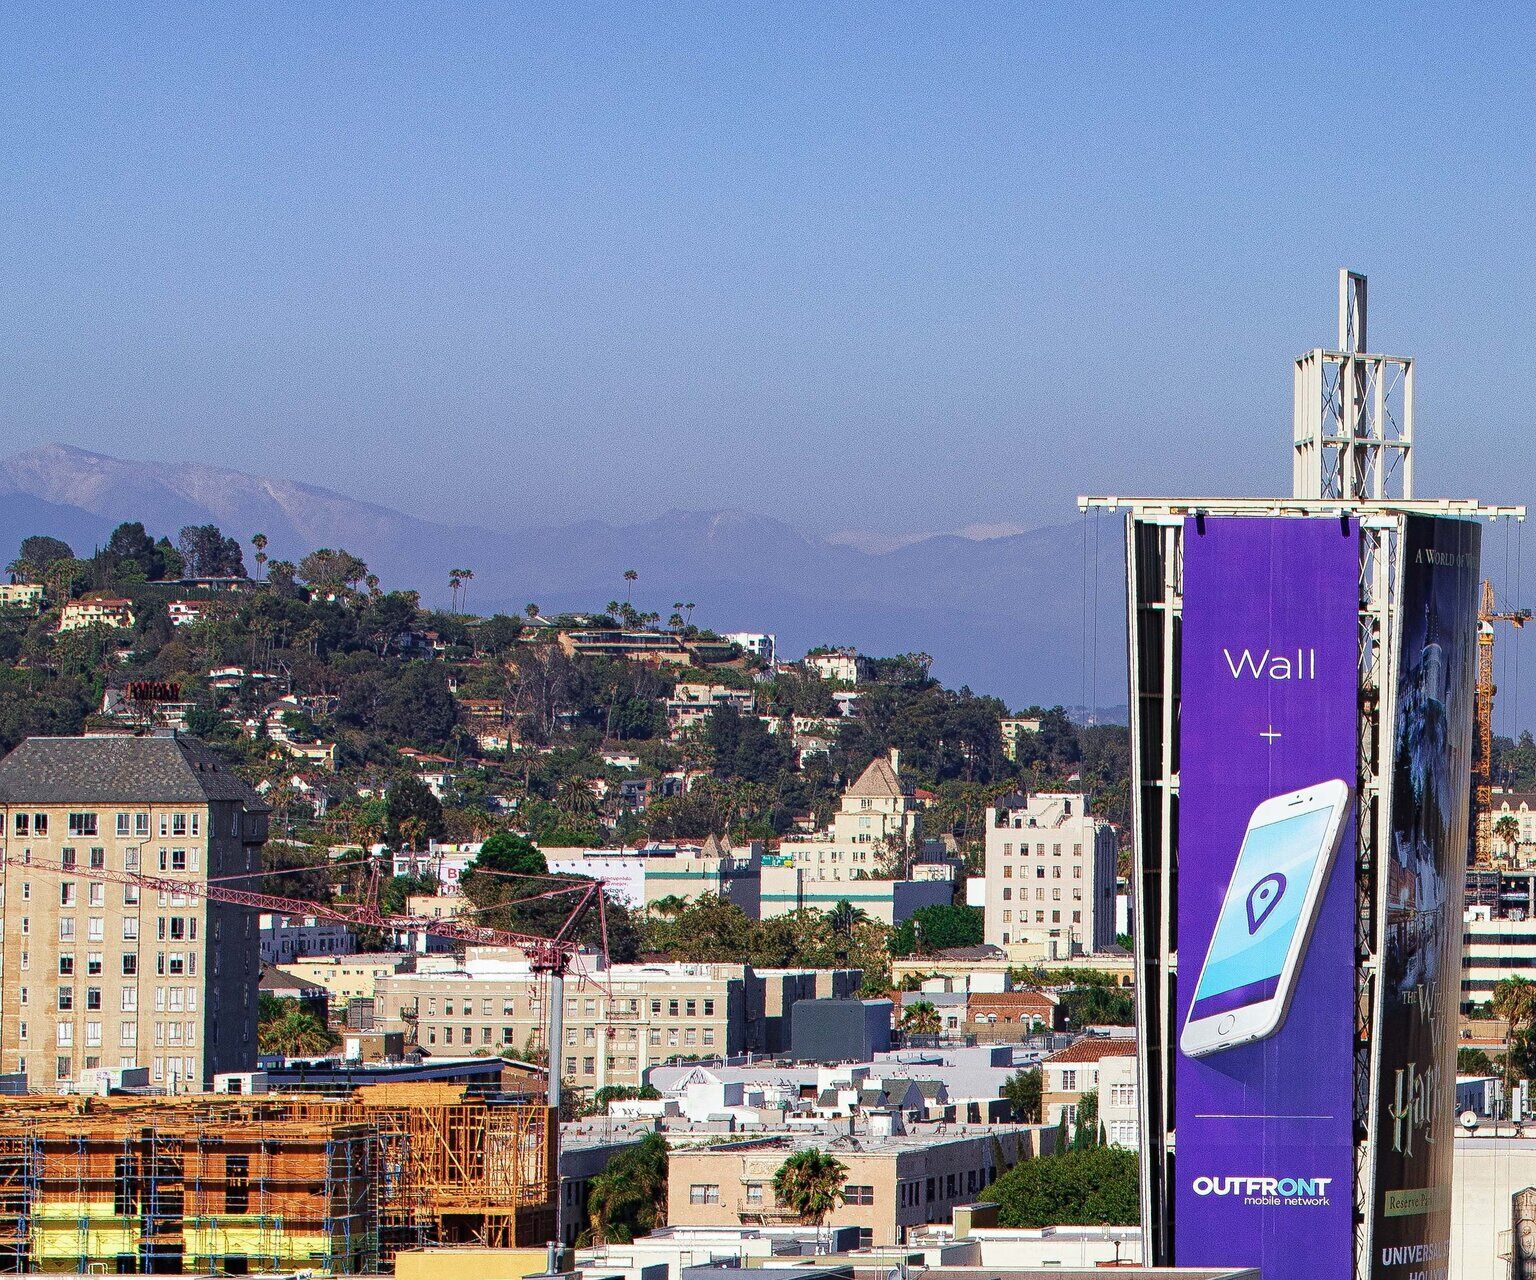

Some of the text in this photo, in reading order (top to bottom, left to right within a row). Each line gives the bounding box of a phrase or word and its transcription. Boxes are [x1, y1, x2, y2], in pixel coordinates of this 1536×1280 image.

[1223, 648, 1315, 680] Wall
[1192, 1176, 1332, 1197] OUTFRONT
[1244, 1196, 1330, 1206] mobile network
